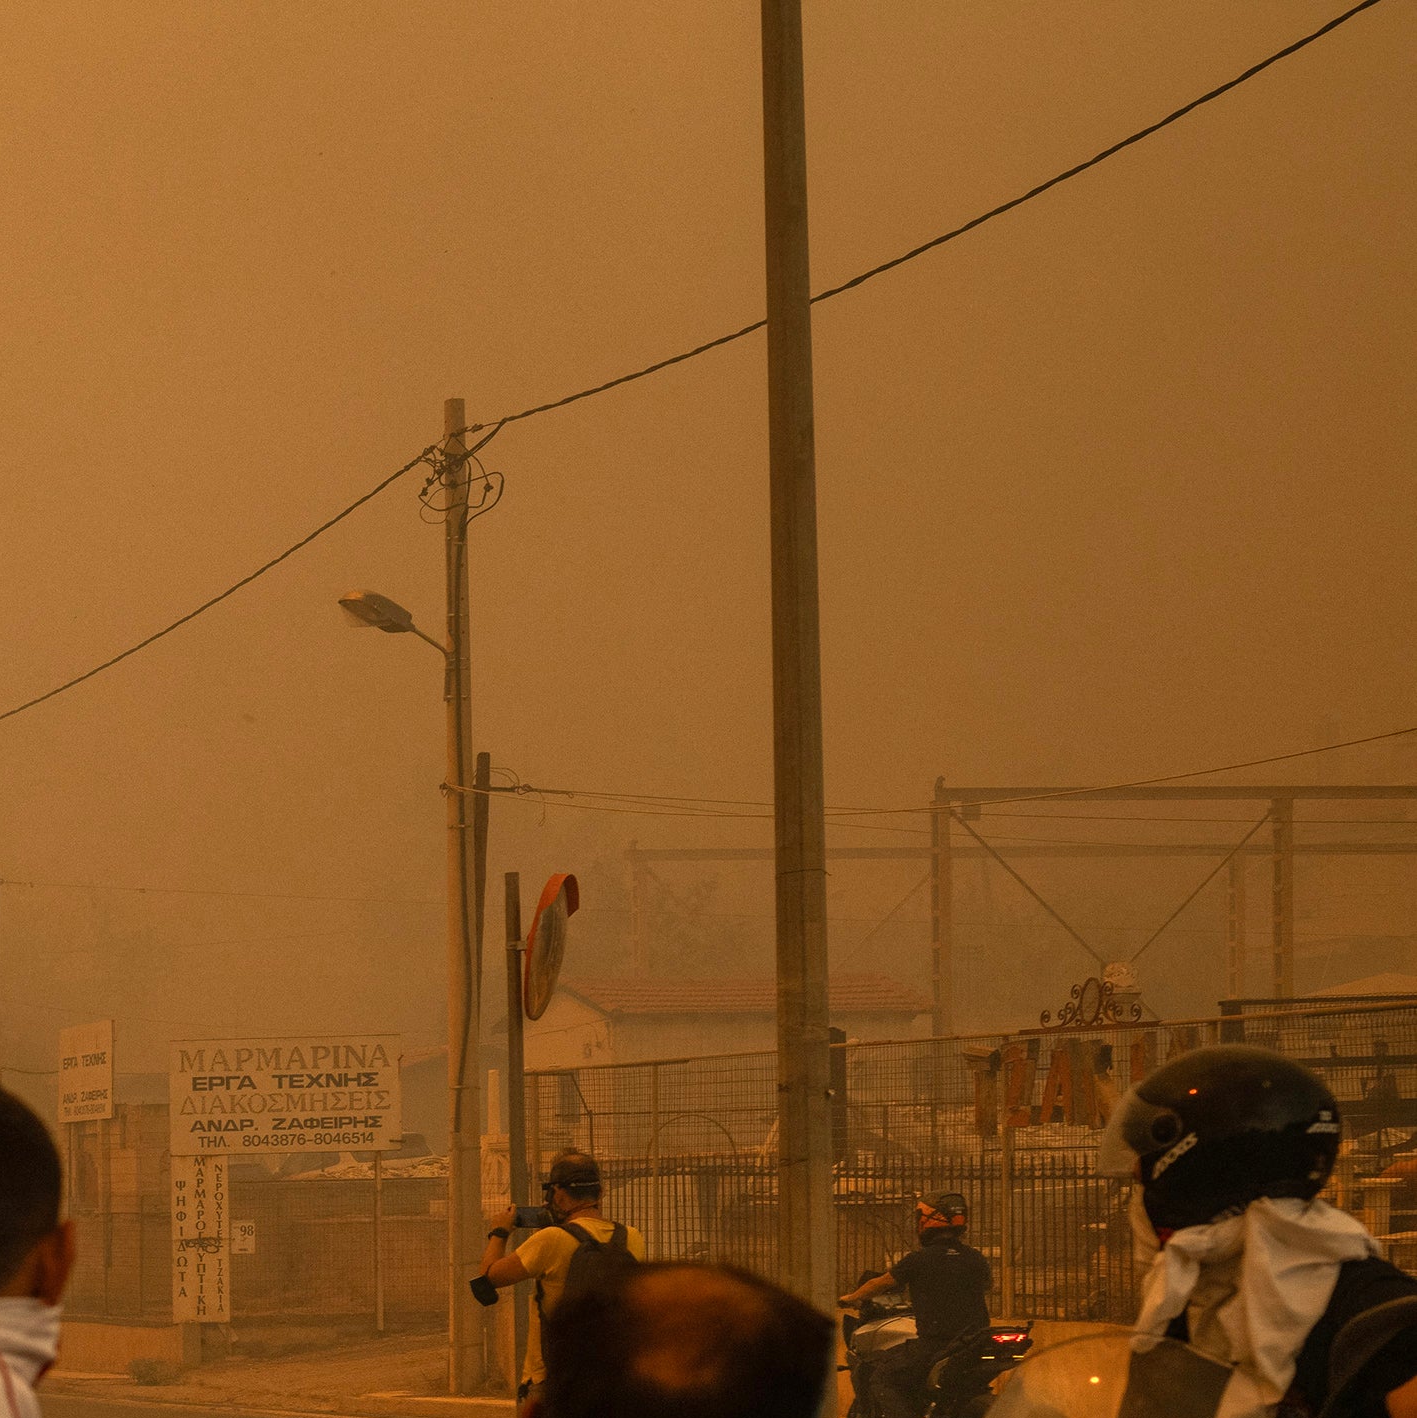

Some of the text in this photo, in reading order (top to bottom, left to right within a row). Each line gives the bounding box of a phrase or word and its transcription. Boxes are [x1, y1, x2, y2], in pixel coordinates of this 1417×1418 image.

[62, 1052, 107, 1070] ΕΡΓΑ ΤΕΧΝΗΣ
[179, 1044, 392, 1073] ΜΑΡΜΑΡΙΝΑ
[192, 1072, 379, 1092] ΕΡΓΑ ΤΕΧΝΗΣ
[179, 1090, 392, 1116] ΔΙΑΚΟΣΜΗΣΕΙΣ
[190, 1115, 383, 1133] ΑΝΔΡ. ΖΑΦΕΙΡΗΣ
[198, 1132, 375, 1148] ΤΗΛ. 8043876-8046514
[175, 1180, 188, 1298] ΨΗΦΙΔΩΤΑ
[240, 1225, 254, 1237] 98
